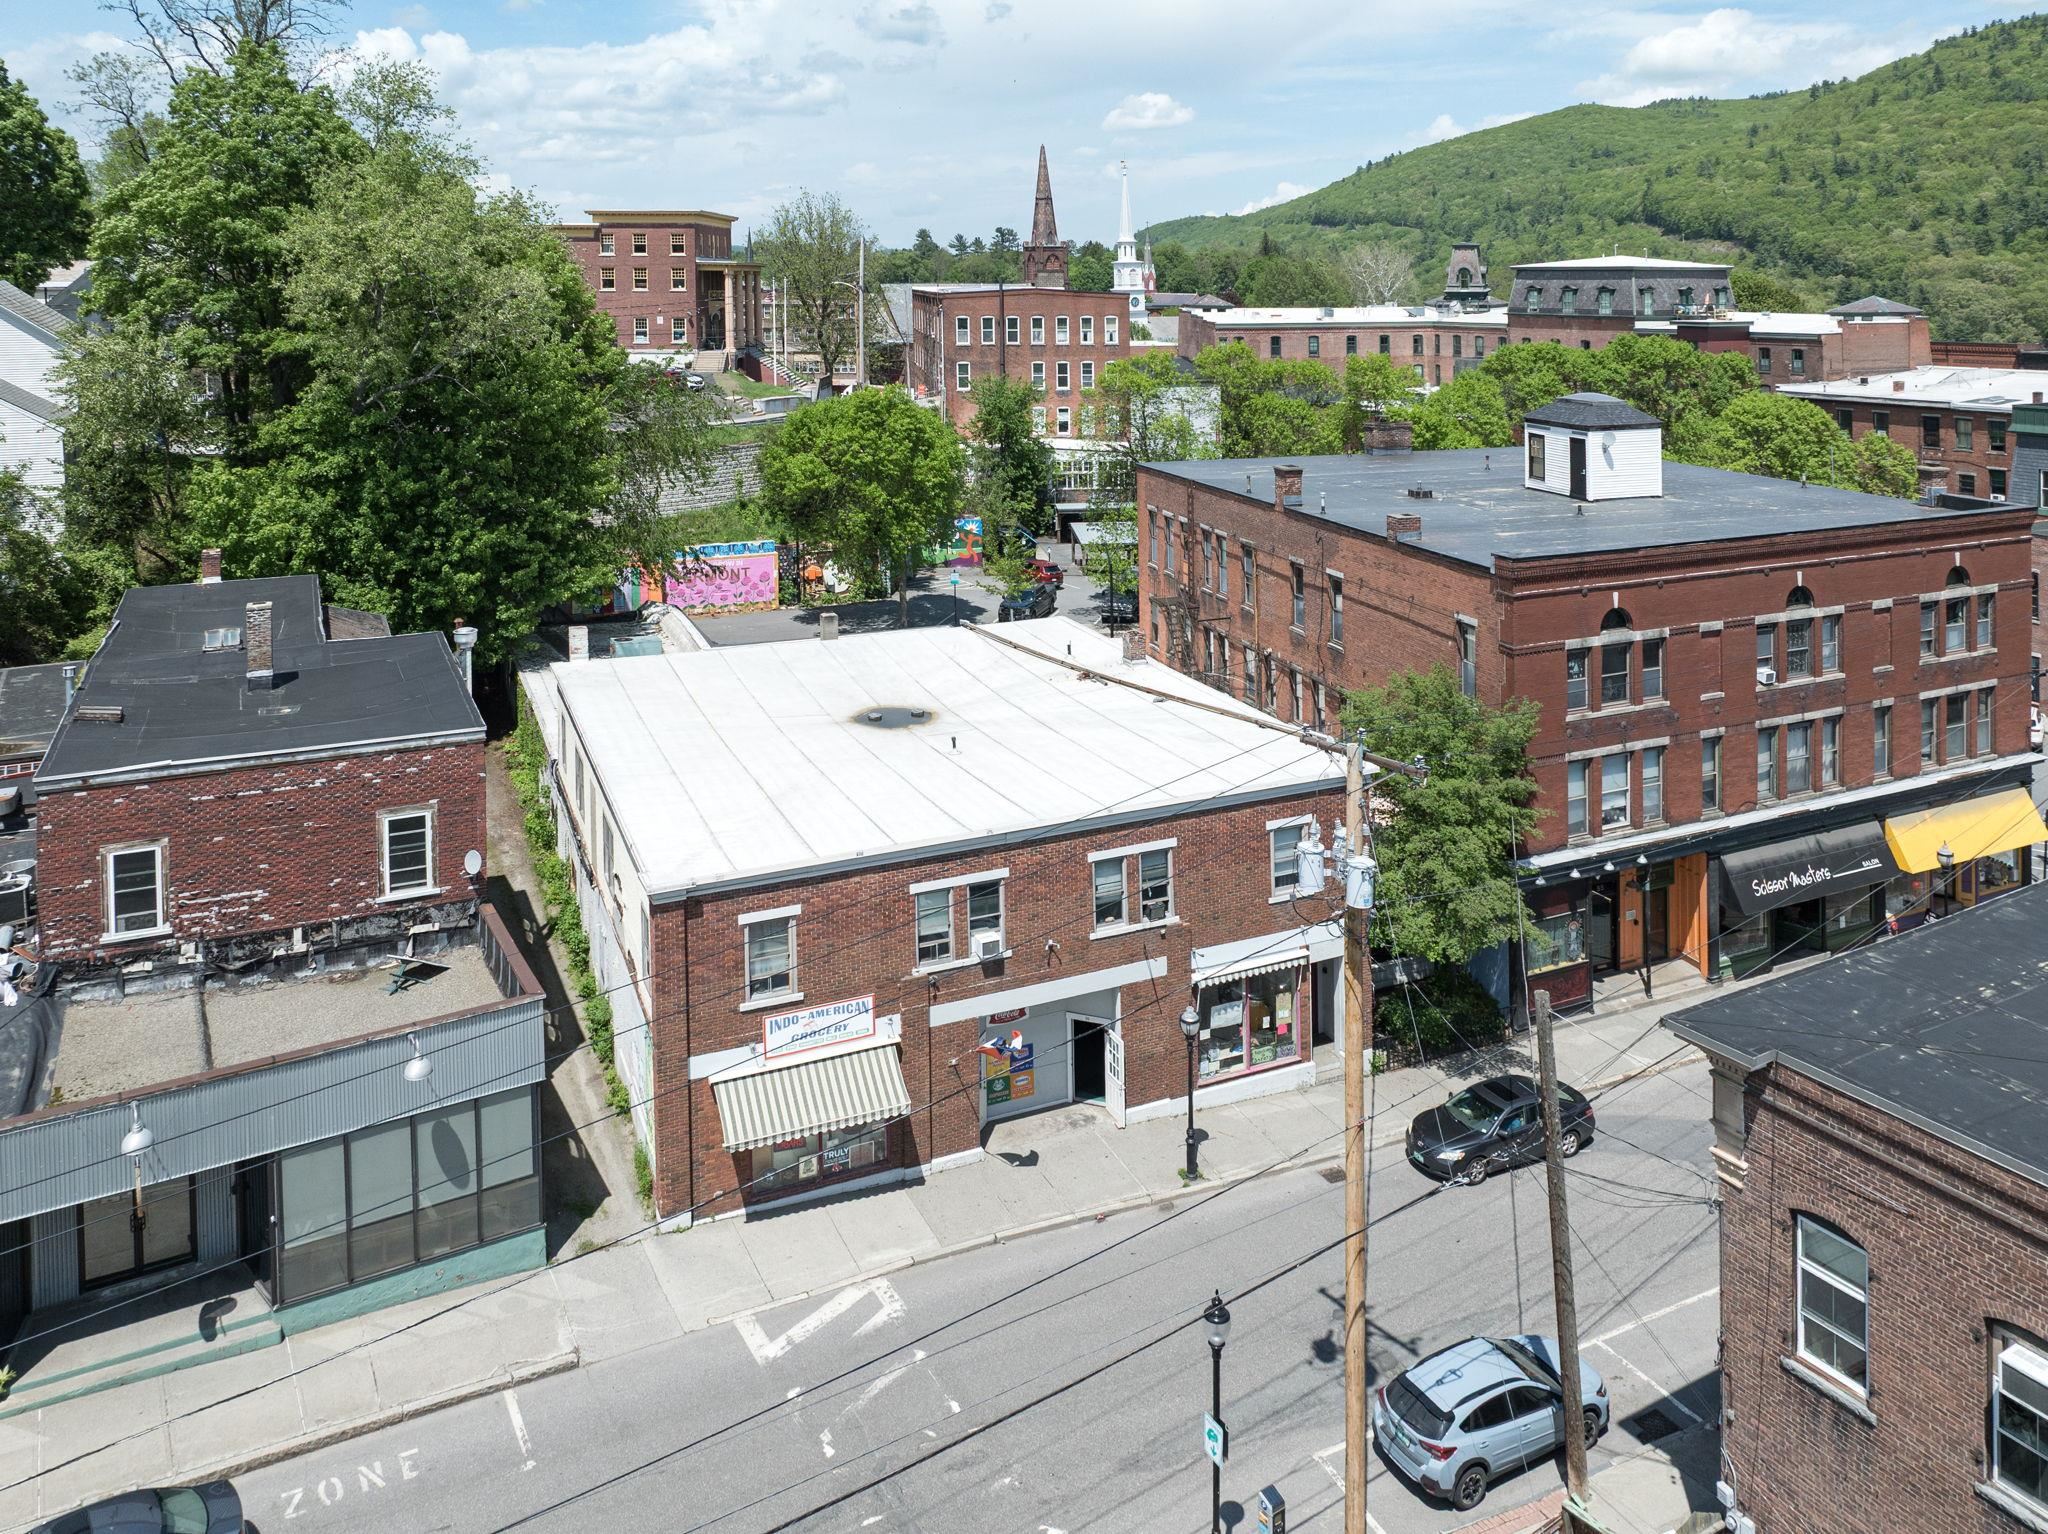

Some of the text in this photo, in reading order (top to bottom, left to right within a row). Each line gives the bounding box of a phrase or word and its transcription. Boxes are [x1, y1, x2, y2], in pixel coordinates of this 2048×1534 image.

[1862, 858, 1880, 868] SALON
[1752, 864, 1831, 897] Scissor Masters
[769, 1000, 870, 1035] INDO-AMERICAN
[791, 1022, 850, 1042] GROCERY
[823, 1147, 850, 1160] TRULY
[281, 1448, 419, 1519] ZONE
